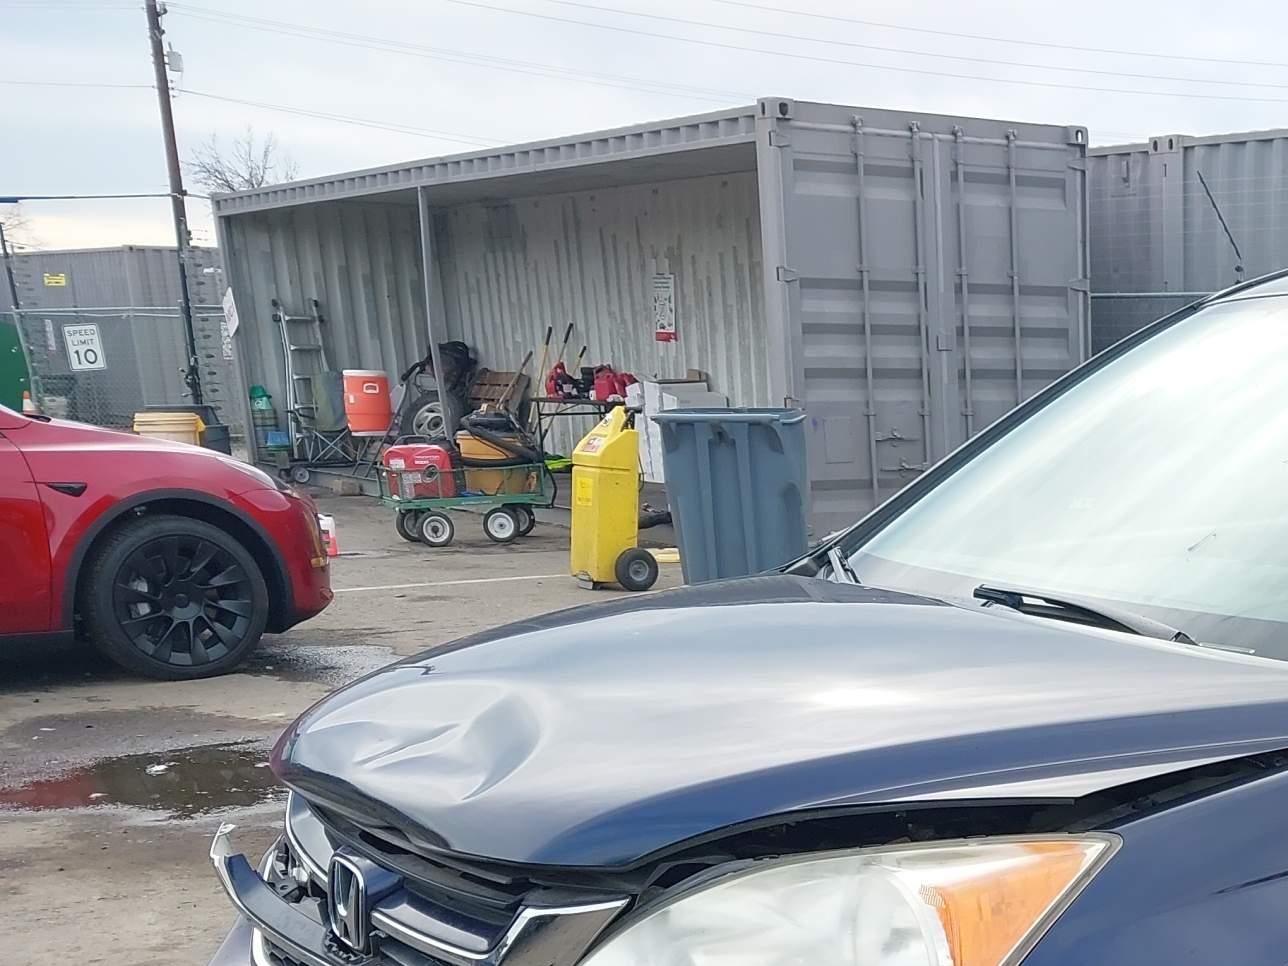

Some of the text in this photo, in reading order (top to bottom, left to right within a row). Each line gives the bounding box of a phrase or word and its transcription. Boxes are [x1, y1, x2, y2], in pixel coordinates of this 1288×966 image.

[66, 328, 95, 337] SPEED
[72, 338, 93, 346] LIMIT
[74, 348, 97, 365] 10
